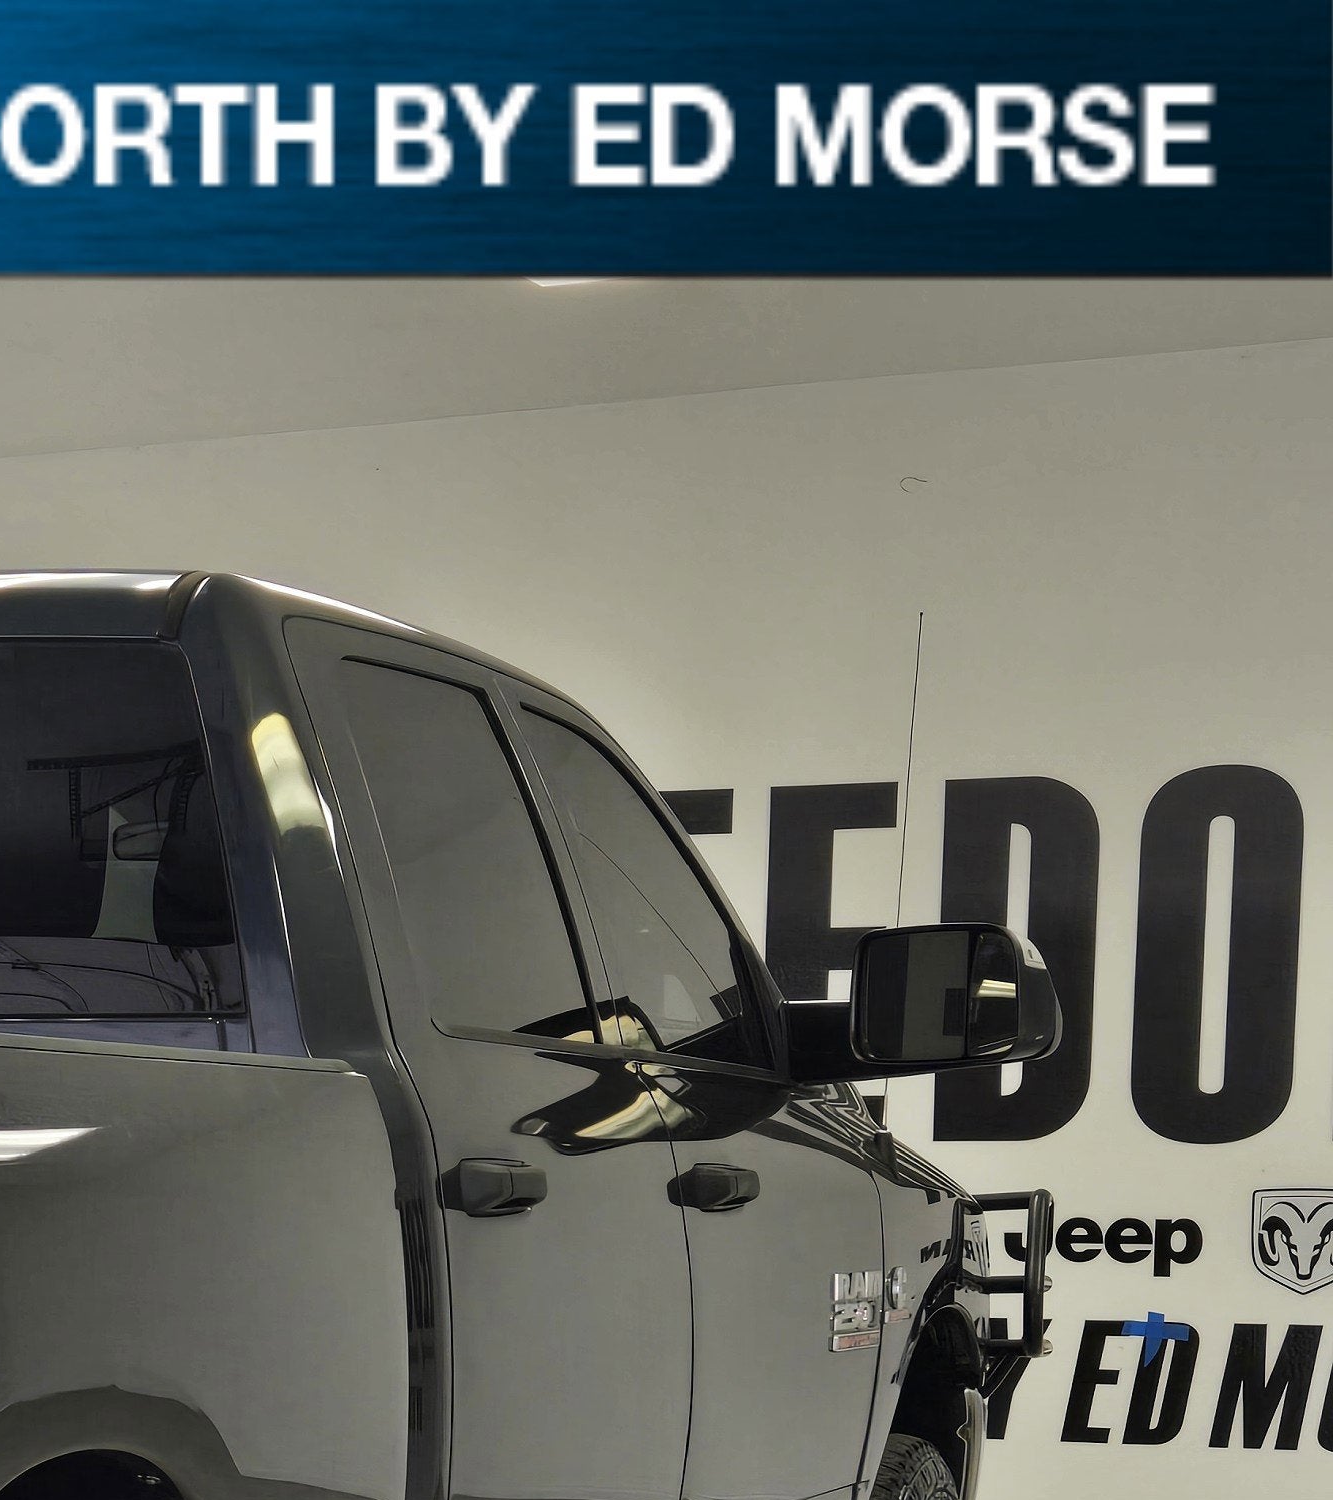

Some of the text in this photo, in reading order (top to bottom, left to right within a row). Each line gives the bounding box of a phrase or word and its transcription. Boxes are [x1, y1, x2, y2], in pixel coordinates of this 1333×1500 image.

[658, 764, 1304, 1145] EDO
[1004, 1217, 1203, 1278] Jeep
[1061, 1320, 1200, 1445] ED
[1209, 1323, 1333, 1453] M
